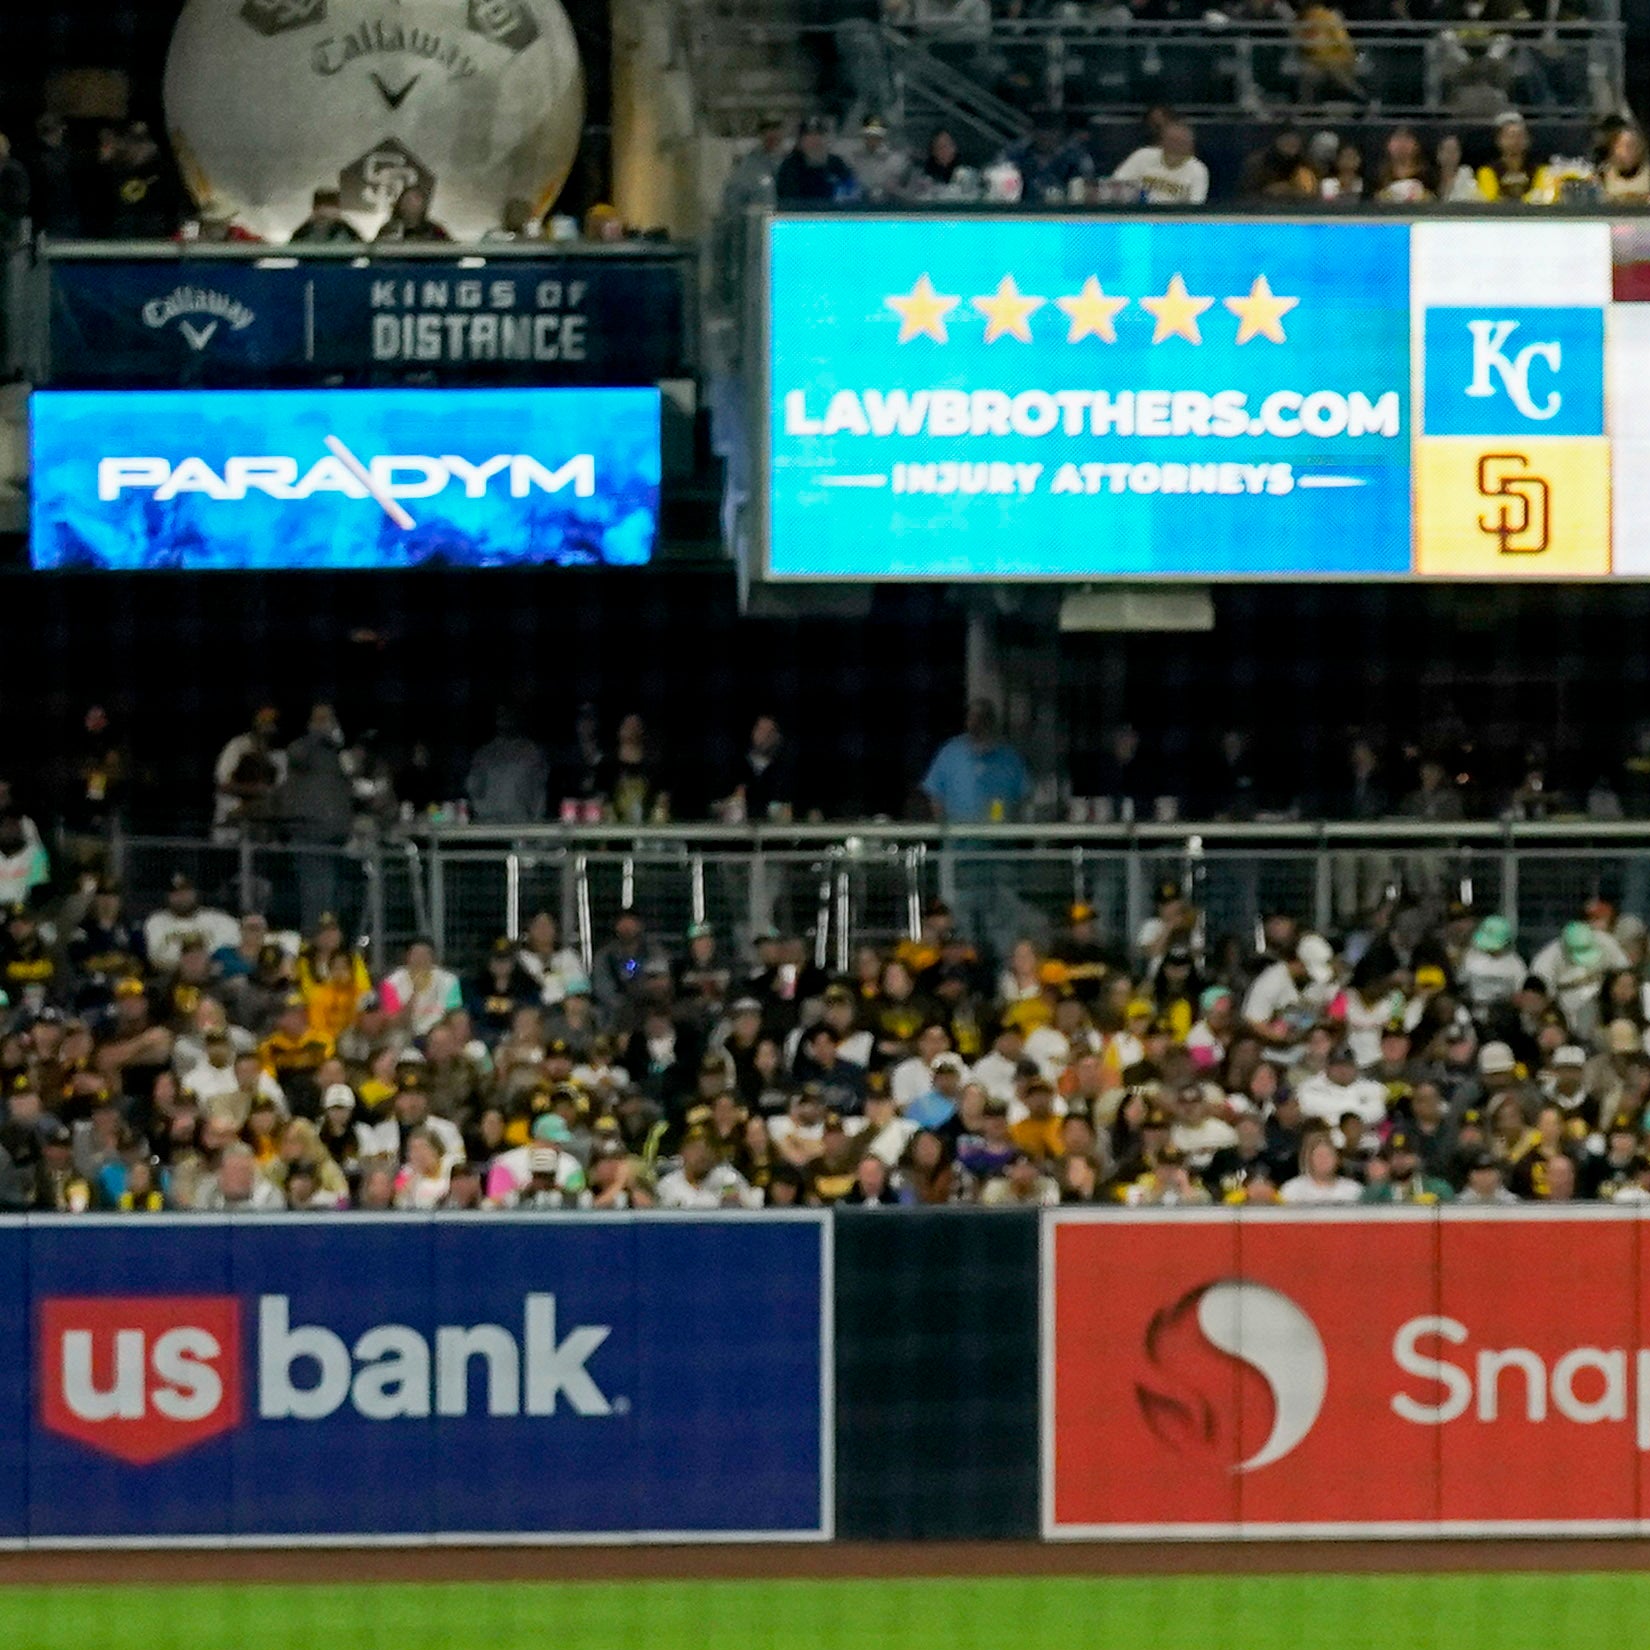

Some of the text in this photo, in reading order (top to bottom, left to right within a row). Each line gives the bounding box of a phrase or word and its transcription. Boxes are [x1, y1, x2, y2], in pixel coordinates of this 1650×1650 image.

[142, 286, 256, 330] Callaway
[371, 279, 589, 307] KINGS OF
[372, 315, 588, 360] DISTANCE
[1464, 318, 1563, 420] KC
[785, 388, 1401, 438] LAWBROTHERS.COM
[97, 440, 596, 520] PARADYM
[892, 462, 1295, 495] INJURY ATTORNEYS
[1476, 453, 1551, 554] SD
[61, 1293, 612, 1421] us bank
